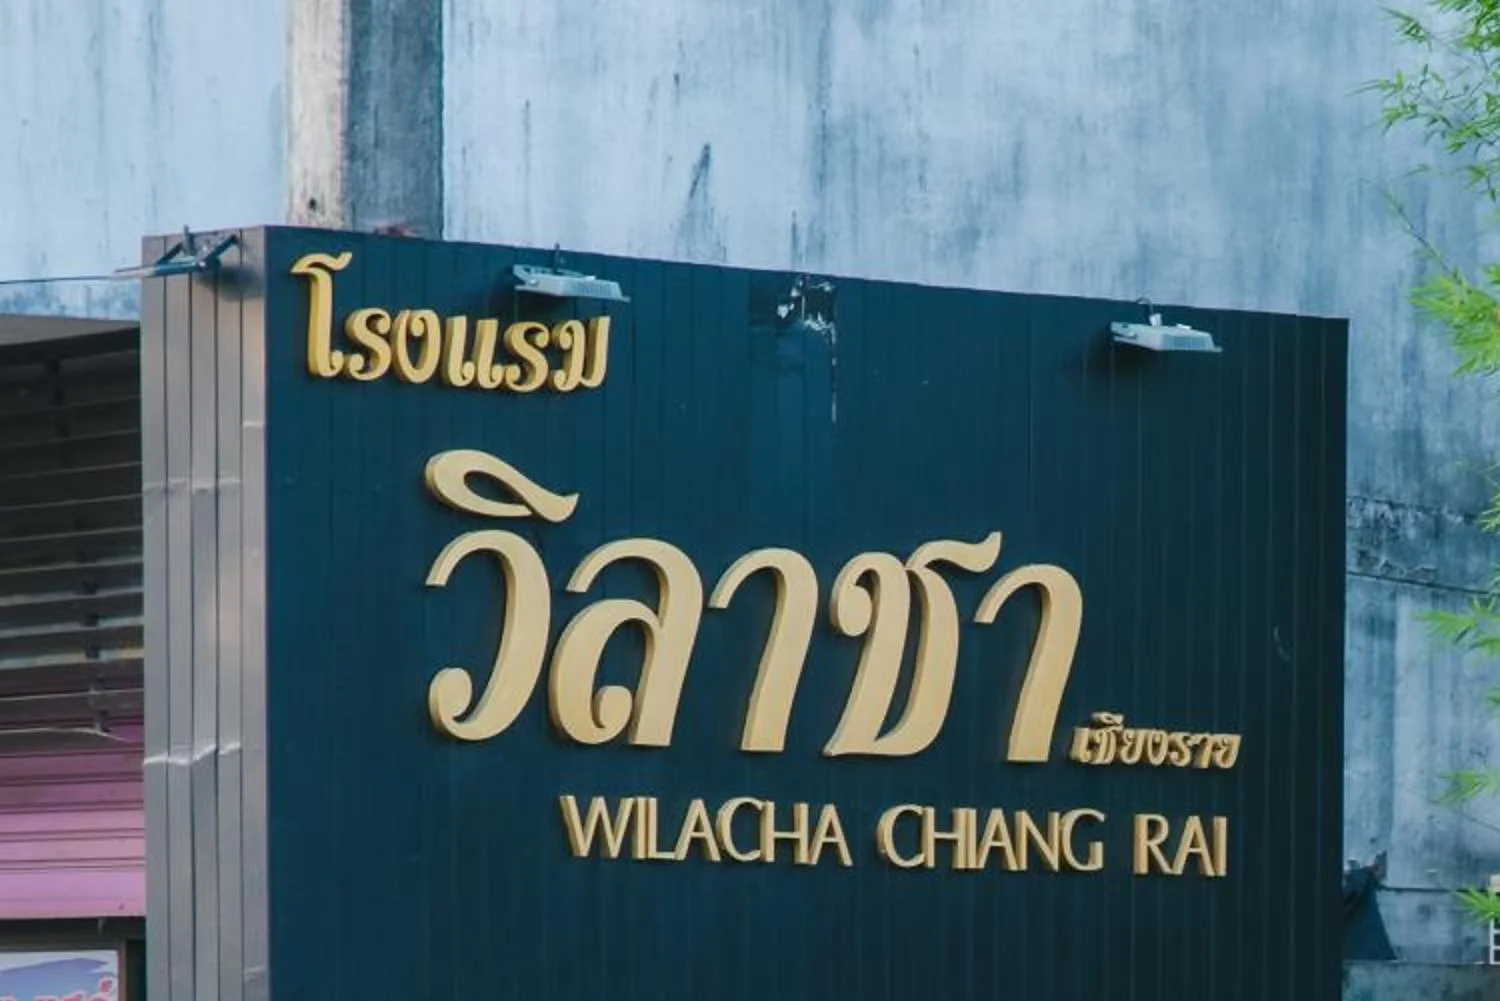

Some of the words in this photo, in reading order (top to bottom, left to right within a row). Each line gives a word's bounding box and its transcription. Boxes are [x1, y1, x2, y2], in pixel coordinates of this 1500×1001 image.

[291, 251, 611, 393] โรงแรม
[424, 449, 1084, 763] วิลาชา
[1070, 711, 1242, 769] เชียงราย
[559, 795, 853, 866] WILACHA
[876, 803, 1105, 872] CHIANG
[1133, 813, 1228, 877] RAI
